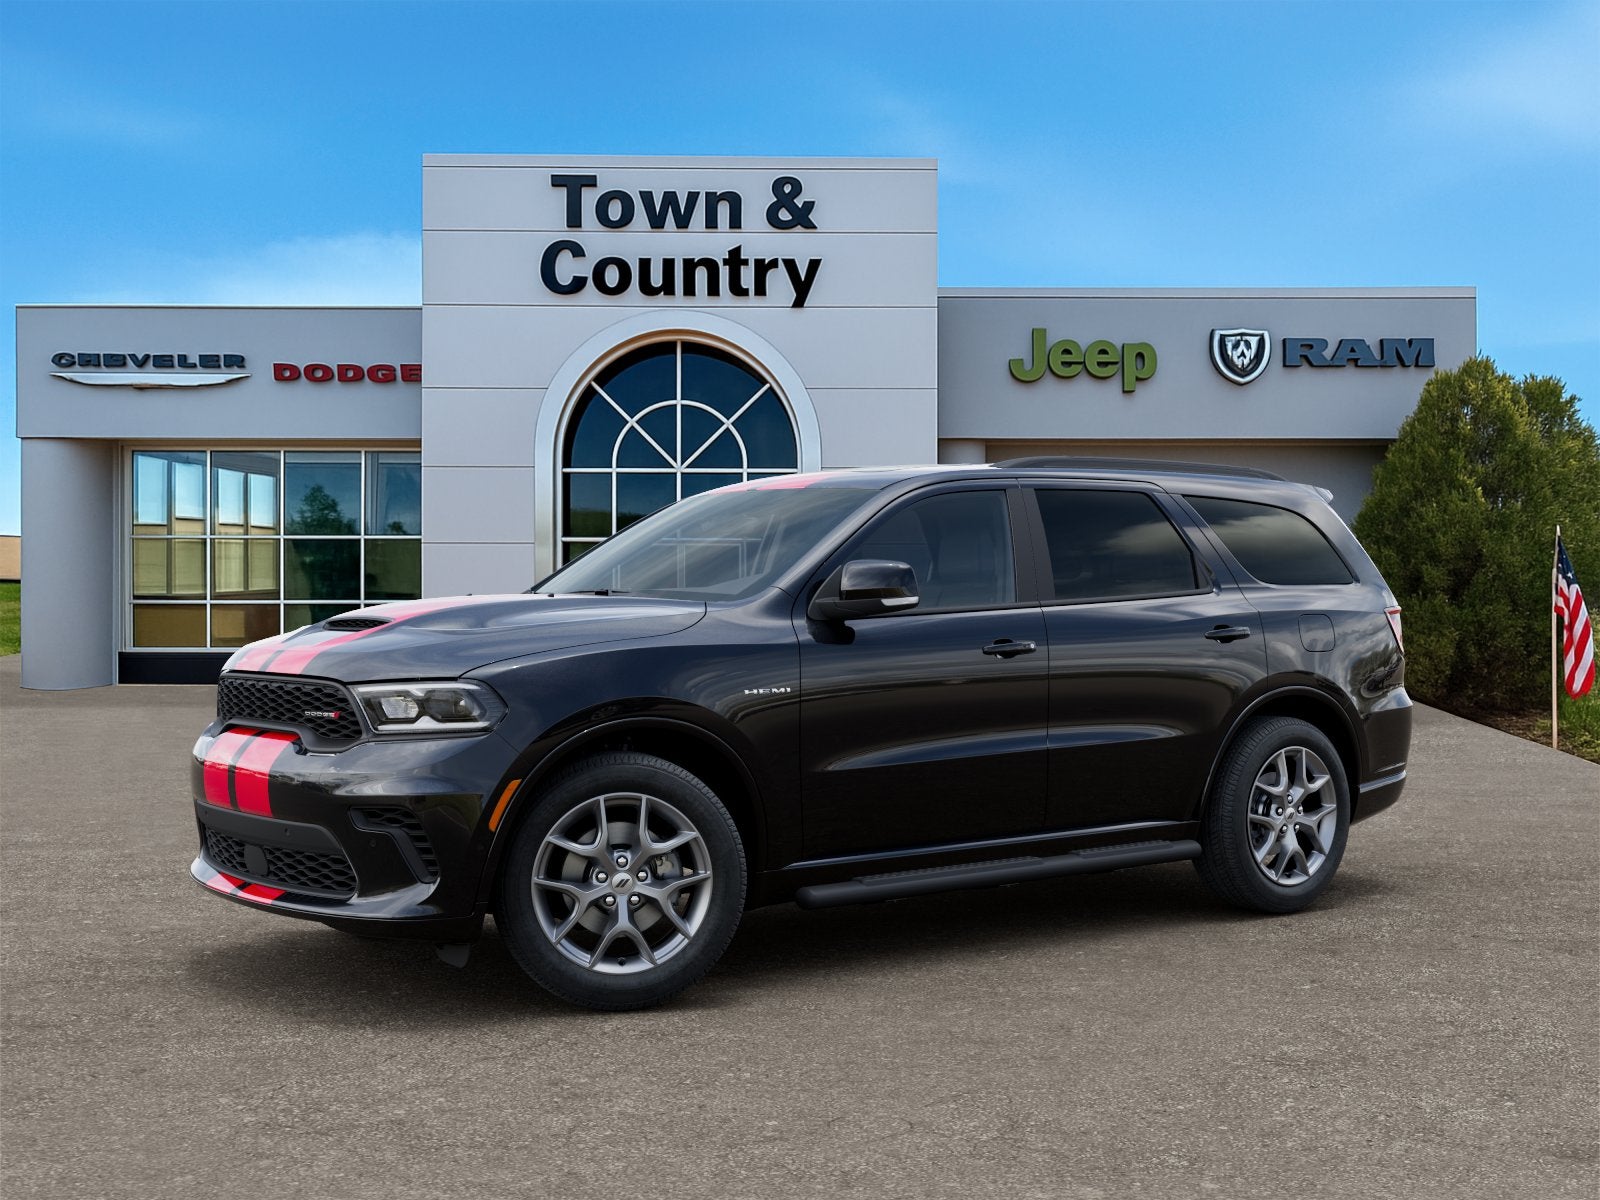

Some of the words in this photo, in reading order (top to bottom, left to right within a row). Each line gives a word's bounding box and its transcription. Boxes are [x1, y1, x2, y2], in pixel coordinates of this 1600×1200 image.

[550, 174, 742, 229] Town
[765, 176, 818, 230] &
[540, 239, 822, 308] Country
[1009, 328, 1157, 392] Jeep
[1282, 337, 1435, 368] RAM
[273, 363, 422, 383] DODGE
[743, 687, 791, 695] HEMI
[304, 710, 335, 718] DODGE
